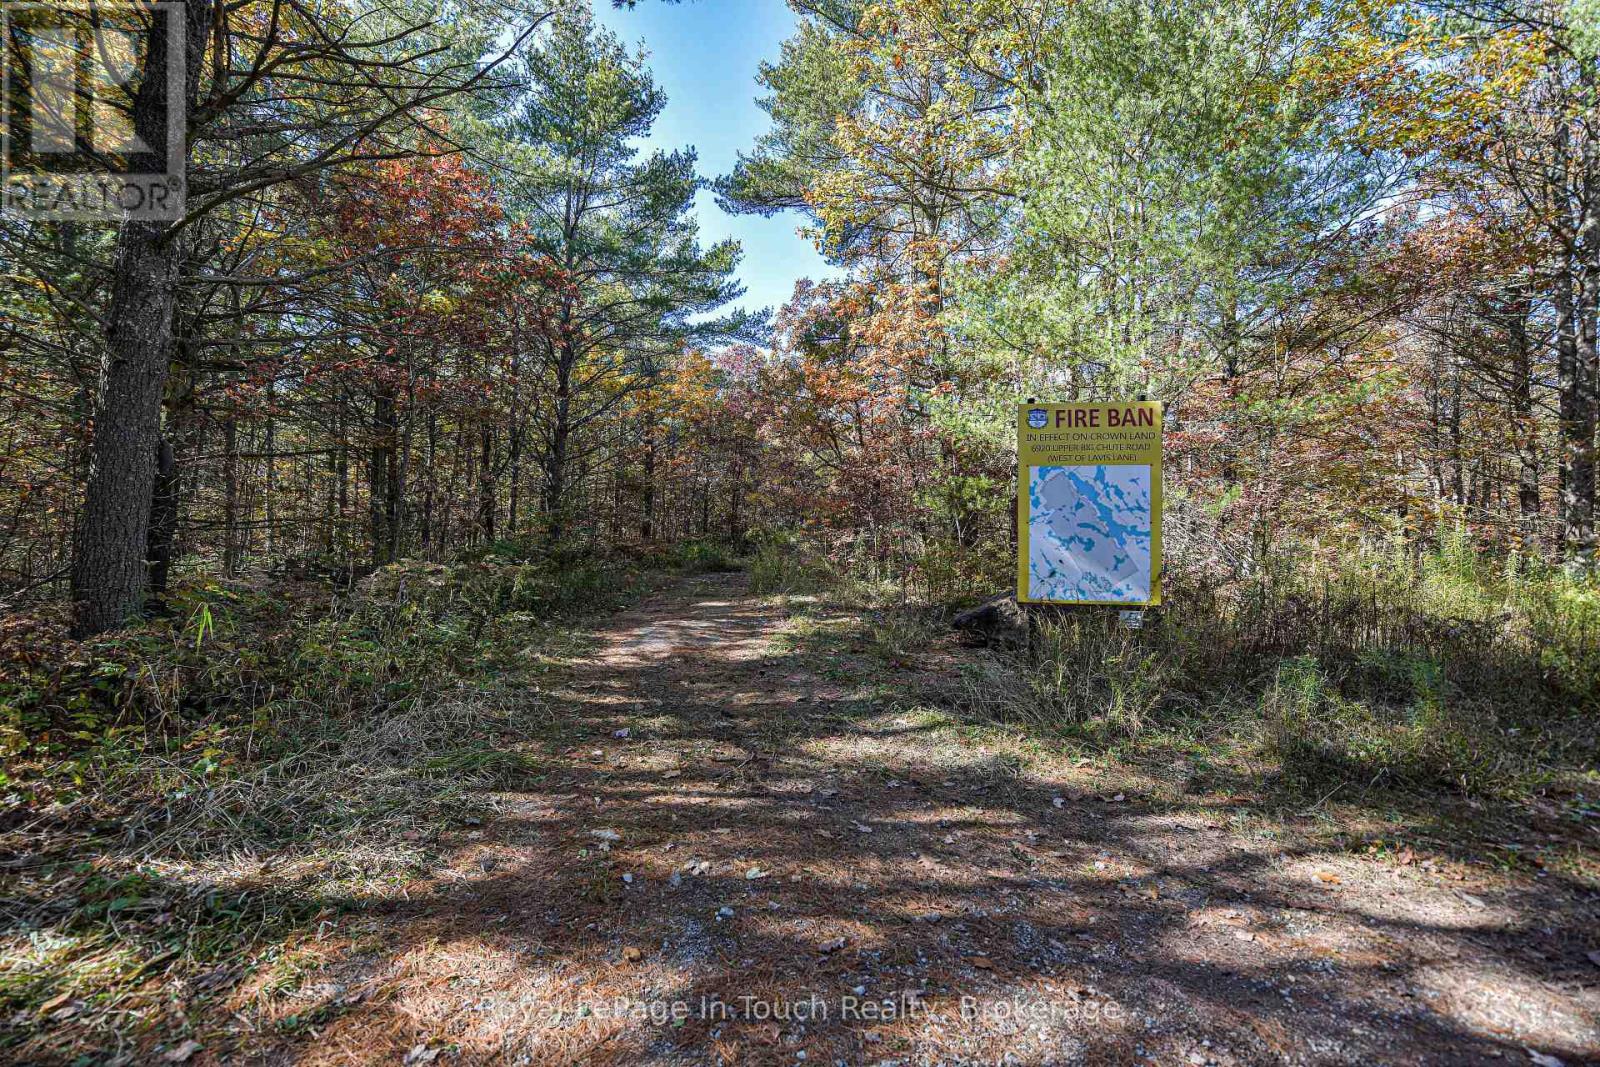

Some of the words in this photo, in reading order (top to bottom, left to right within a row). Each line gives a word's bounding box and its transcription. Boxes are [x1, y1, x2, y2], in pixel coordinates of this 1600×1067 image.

[1055, 408, 1100, 428] FIRE
[1107, 407, 1154, 427] BAN
[1026, 433, 1037, 442] IN
[1040, 433, 1071, 441] EFFECT
[1072, 432, 1088, 441] ON
[1090, 432, 1127, 440] CROWN
[1129, 431, 1156, 440] LAND
[1052, 444, 1078, 452] UPPER
[1096, 443, 1124, 451] CHUTE
[1125, 443, 1151, 451] ROAD
[1047, 454, 1072, 463] (WEST
[1074, 454, 1086, 462] OF
[1088, 453, 1110, 462] LAVIS
